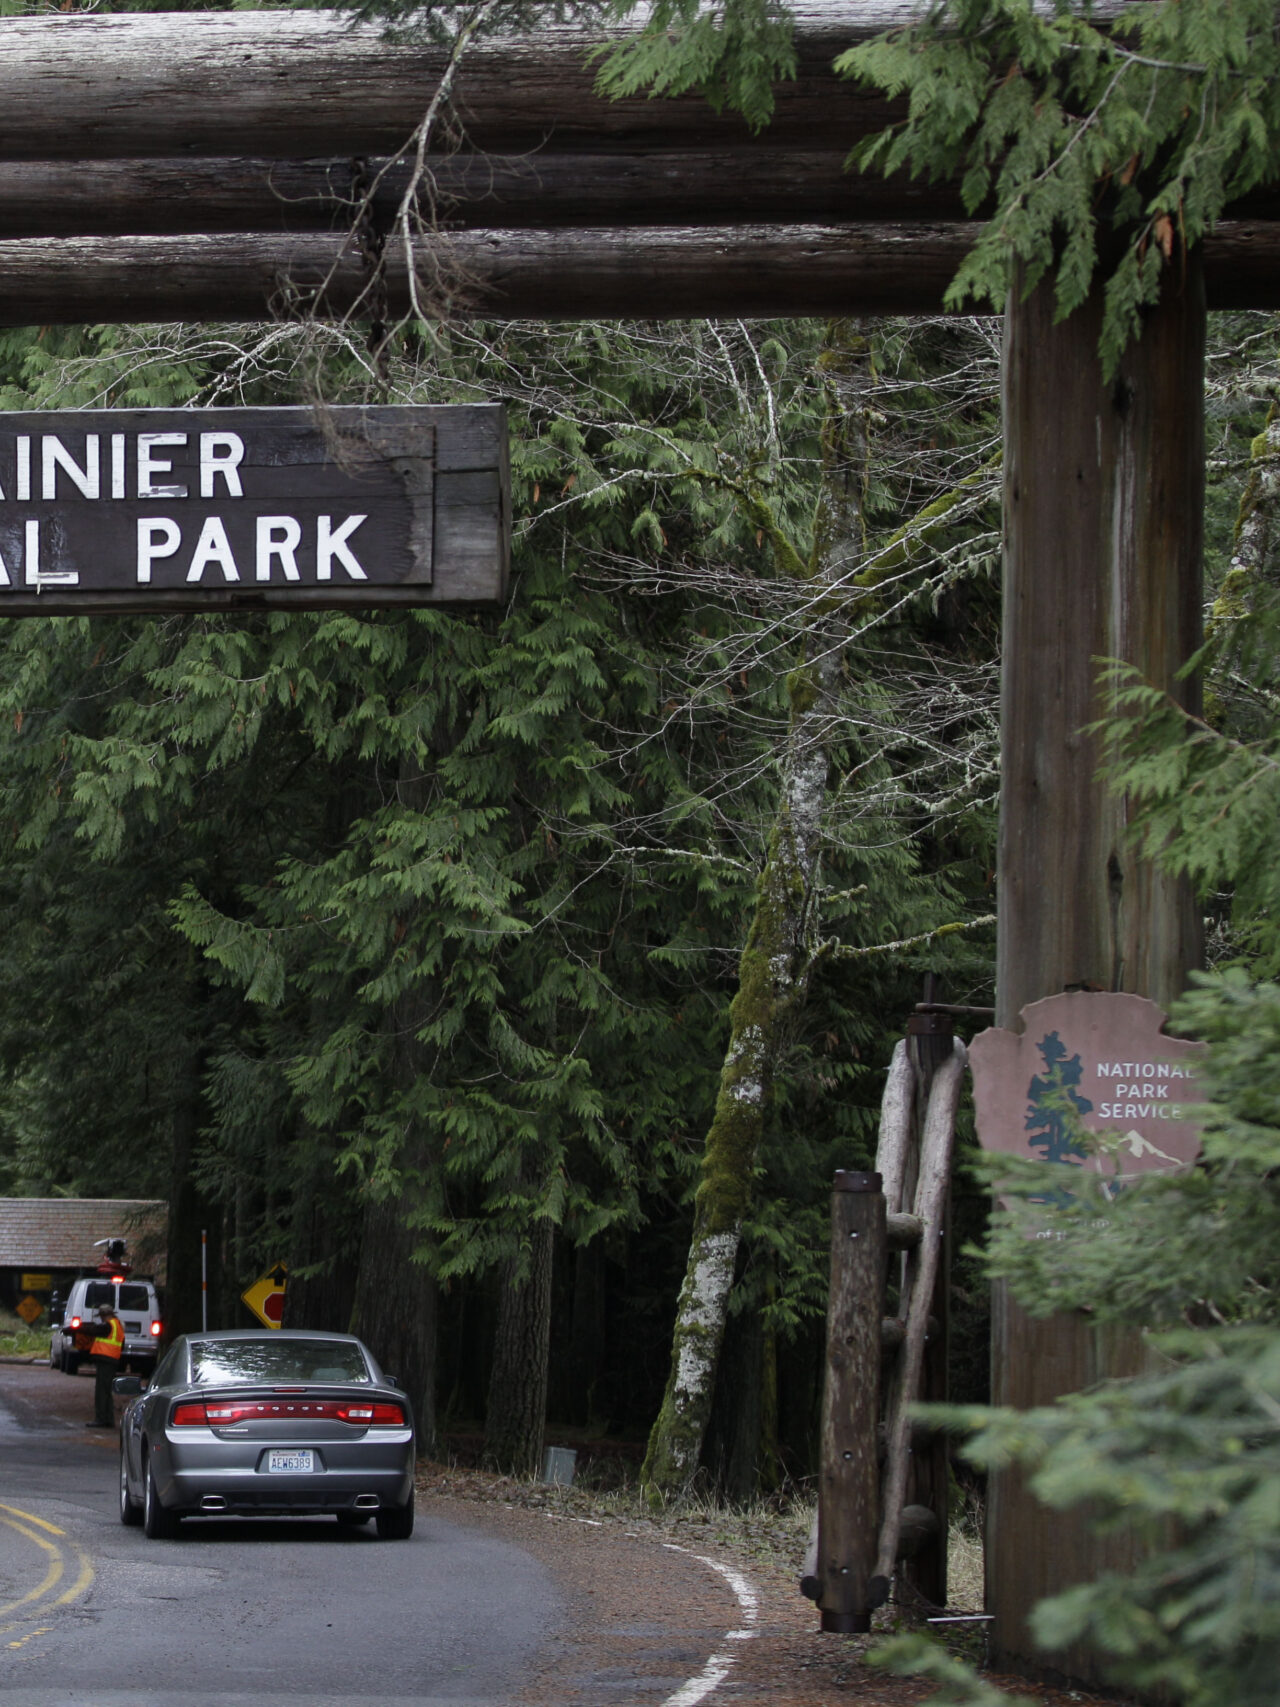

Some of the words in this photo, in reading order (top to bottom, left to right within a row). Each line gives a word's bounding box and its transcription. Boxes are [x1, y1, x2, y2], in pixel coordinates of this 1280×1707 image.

[137, 514, 368, 583] PARK
[1096, 1062, 1196, 1079] NATIONAL
[1115, 1083, 1169, 1099] PARK
[1097, 1102, 1183, 1120] SERVICE
